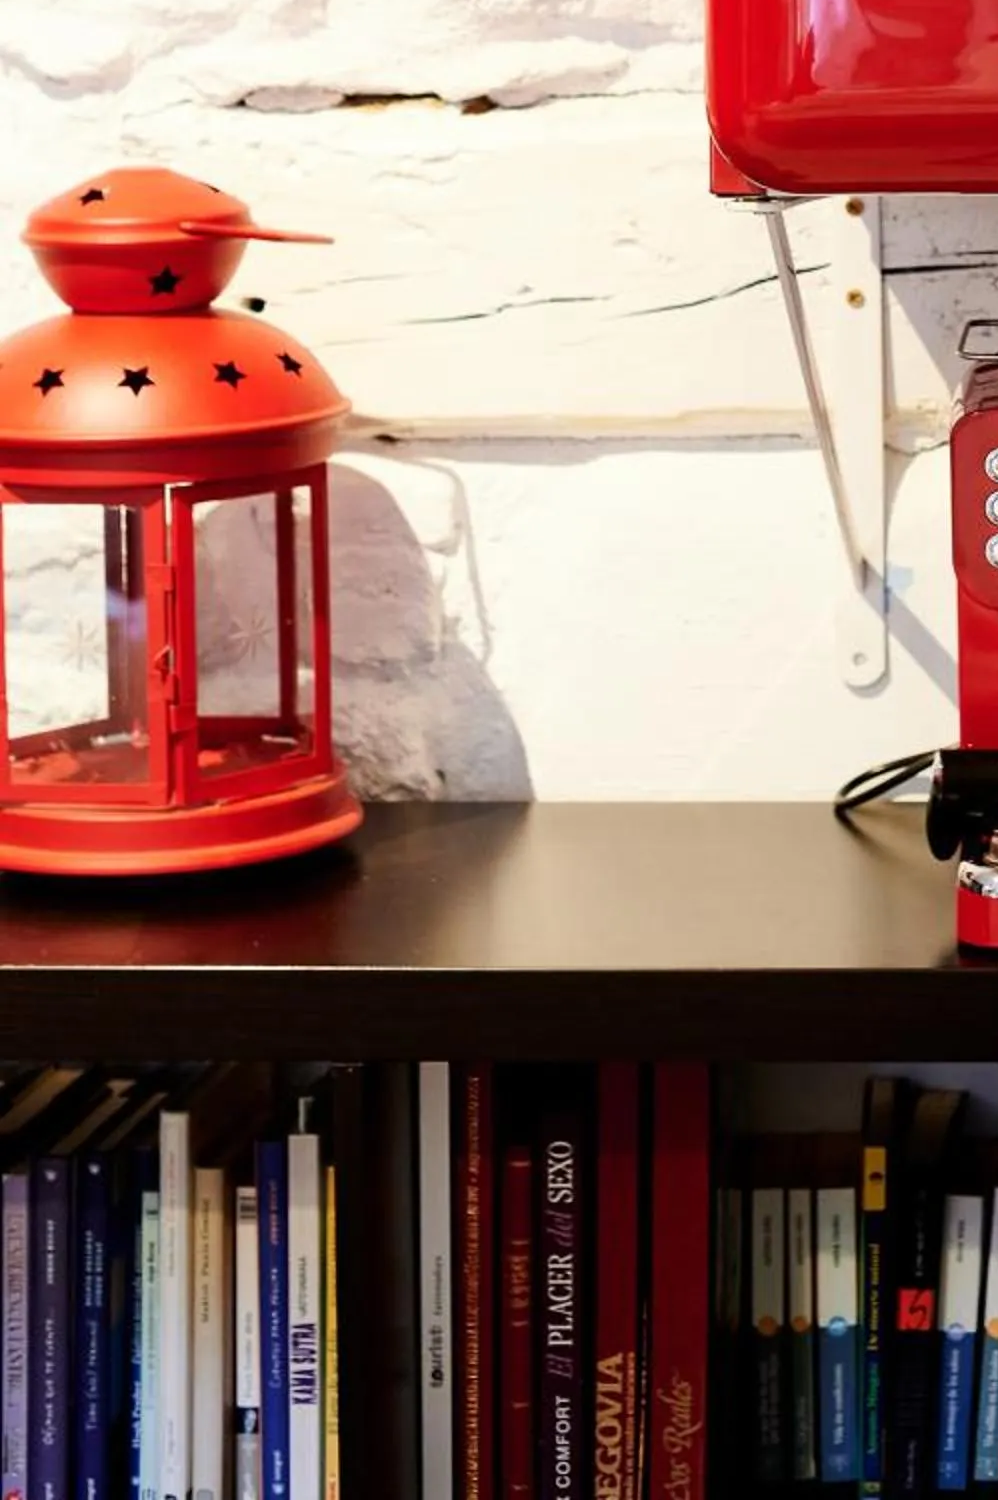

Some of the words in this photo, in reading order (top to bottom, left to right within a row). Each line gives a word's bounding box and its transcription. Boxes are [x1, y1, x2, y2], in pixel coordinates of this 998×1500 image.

[547, 1141, 574, 1204] SEXO
[547, 1210, 574, 1248] del
[547, 1253, 574, 1347] PLACER
[291, 1323, 316, 1365] SUTRA
[429, 1327, 443, 1388] tourist
[546, 1353, 574, 1379] El
[292, 1369, 316, 1405] KAMA
[656, 1366, 702, 1453] Reales
[555, 1395, 571, 1489] COMFORT
[594, 1352, 623, 1500] EGOVIA
